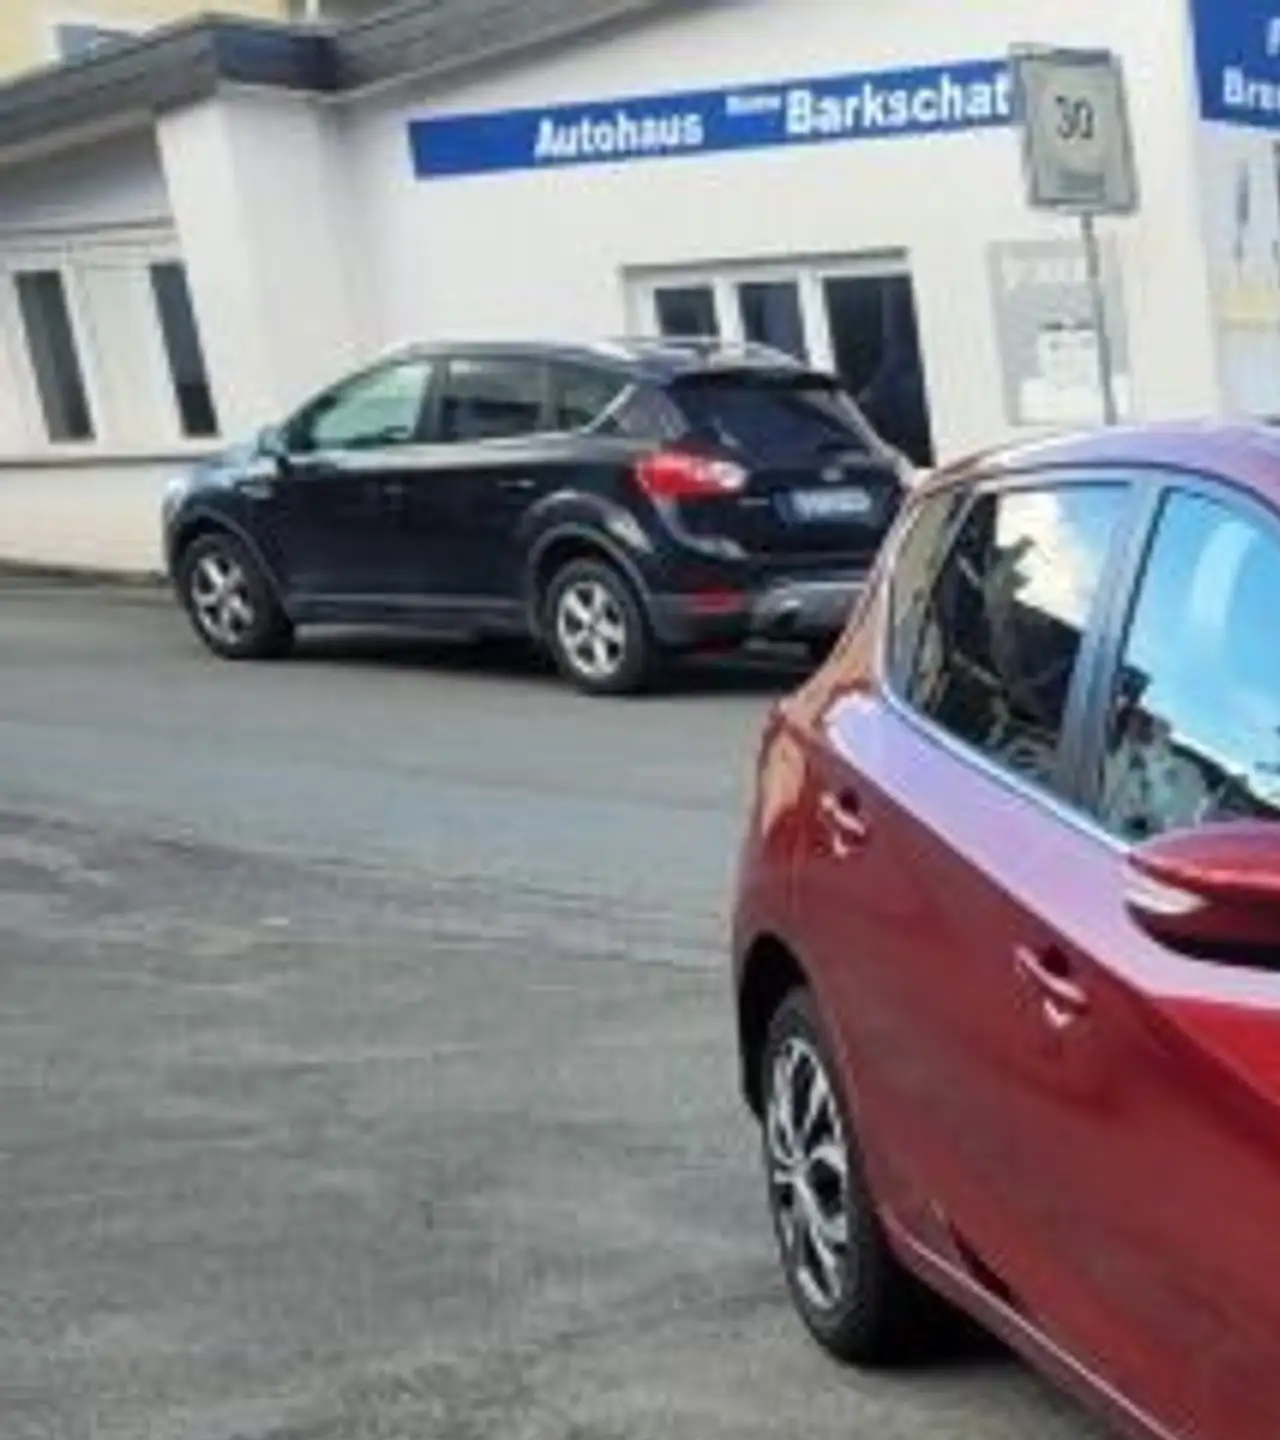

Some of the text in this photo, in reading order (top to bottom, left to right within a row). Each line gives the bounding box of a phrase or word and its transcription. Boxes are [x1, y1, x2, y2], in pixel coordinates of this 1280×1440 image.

[533, 71, 1010, 159] Autohaus Barkschat
[1055, 94, 1094, 141] 30
